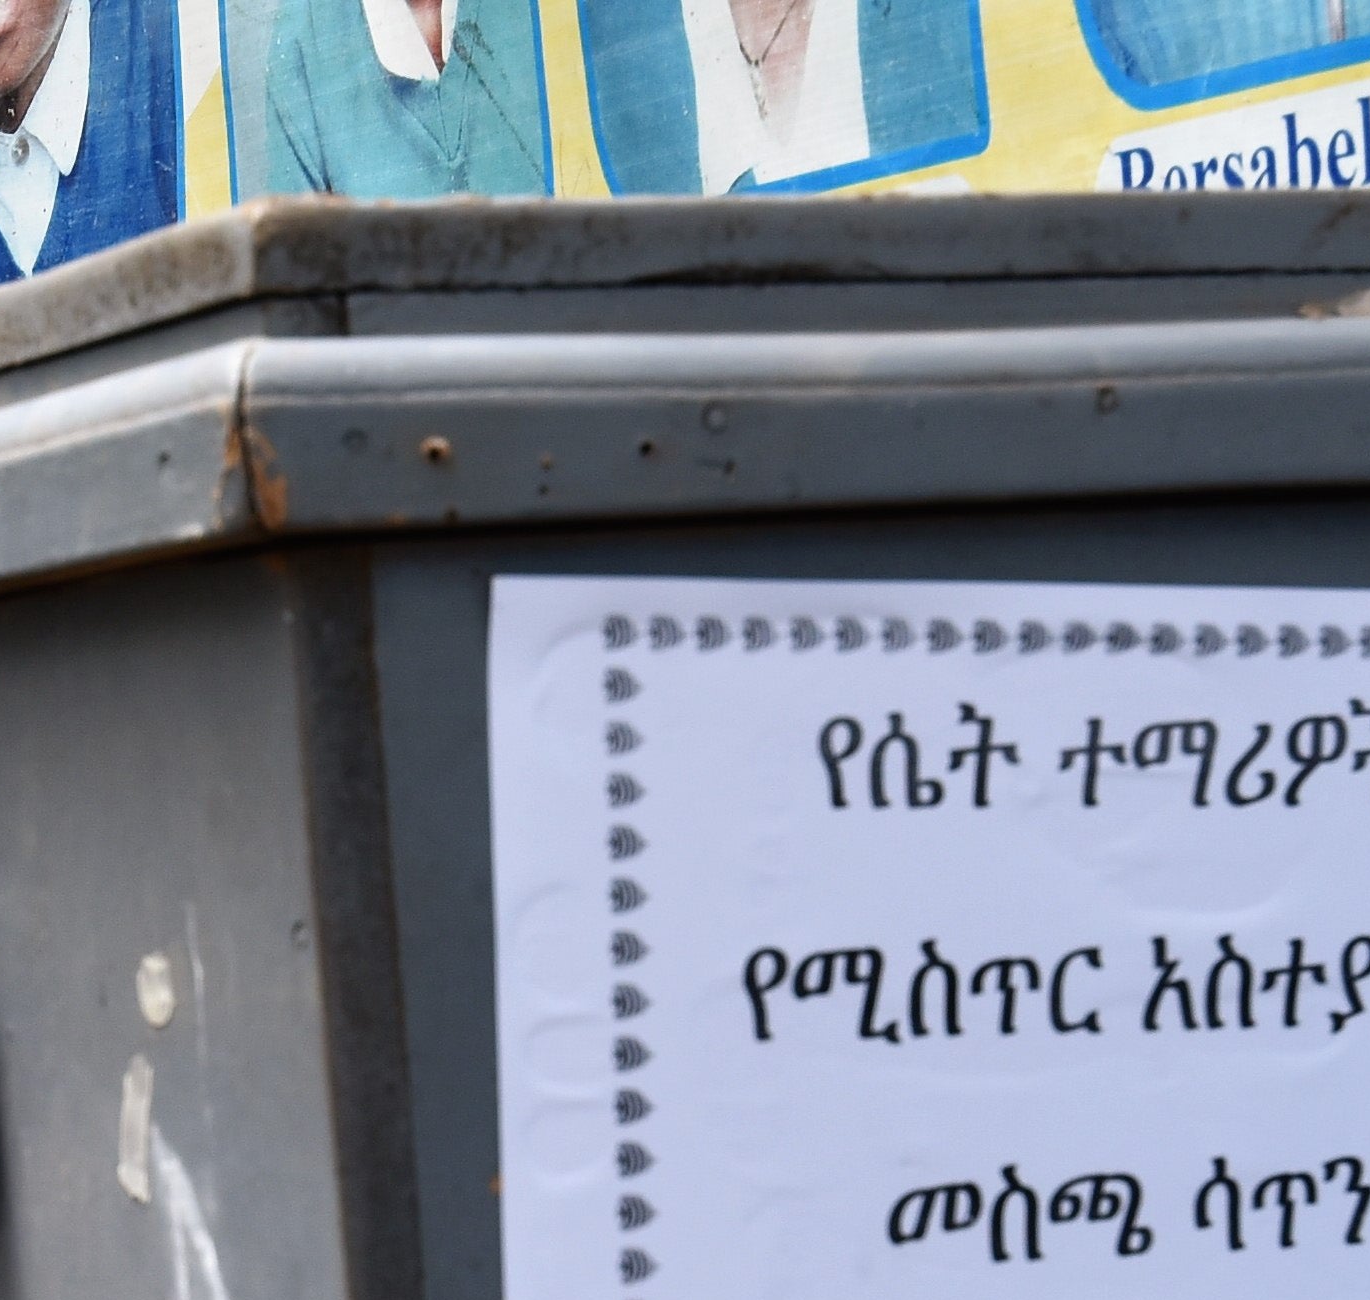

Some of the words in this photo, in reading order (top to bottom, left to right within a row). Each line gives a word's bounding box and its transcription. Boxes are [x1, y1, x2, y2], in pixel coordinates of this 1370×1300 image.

[819, 703, 1019, 810] የሴት
[743, 939, 1103, 1044] የሚስጥር
[886, 1164, 1154, 1263] መስጫ
